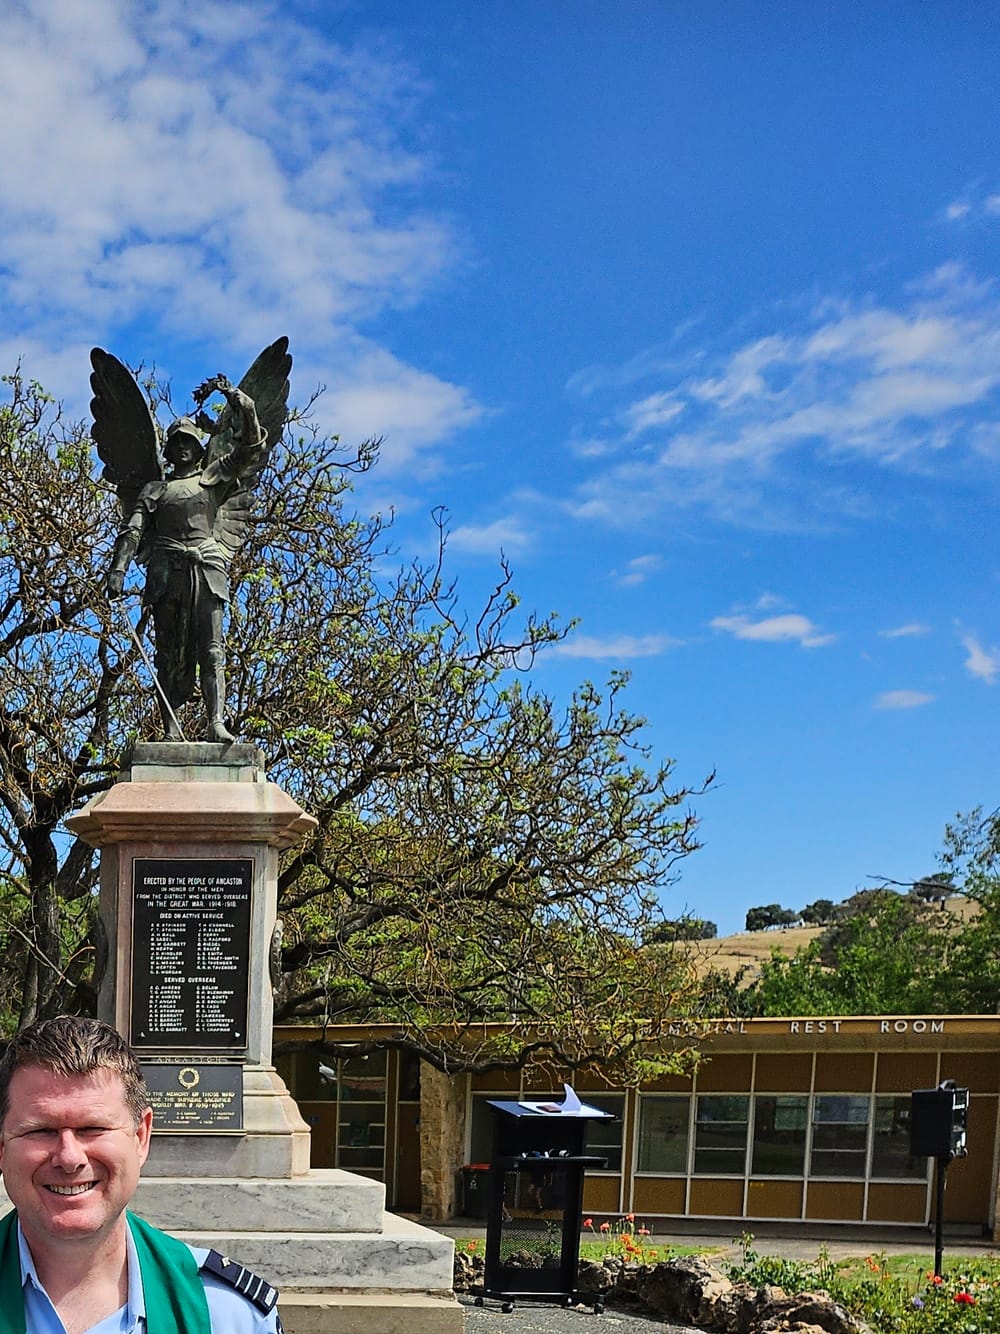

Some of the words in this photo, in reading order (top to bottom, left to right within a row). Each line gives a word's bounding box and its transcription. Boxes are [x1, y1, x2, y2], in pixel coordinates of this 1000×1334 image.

[143, 877, 167, 886] ERECTED
[168, 877, 175, 886] BY
[176, 877, 186, 886] THE
[187, 877, 206, 886] PEOPLE
[207, 877, 215, 886] OF
[790, 1021, 842, 1033] REST
[880, 1020, 945, 1033] ROOM
